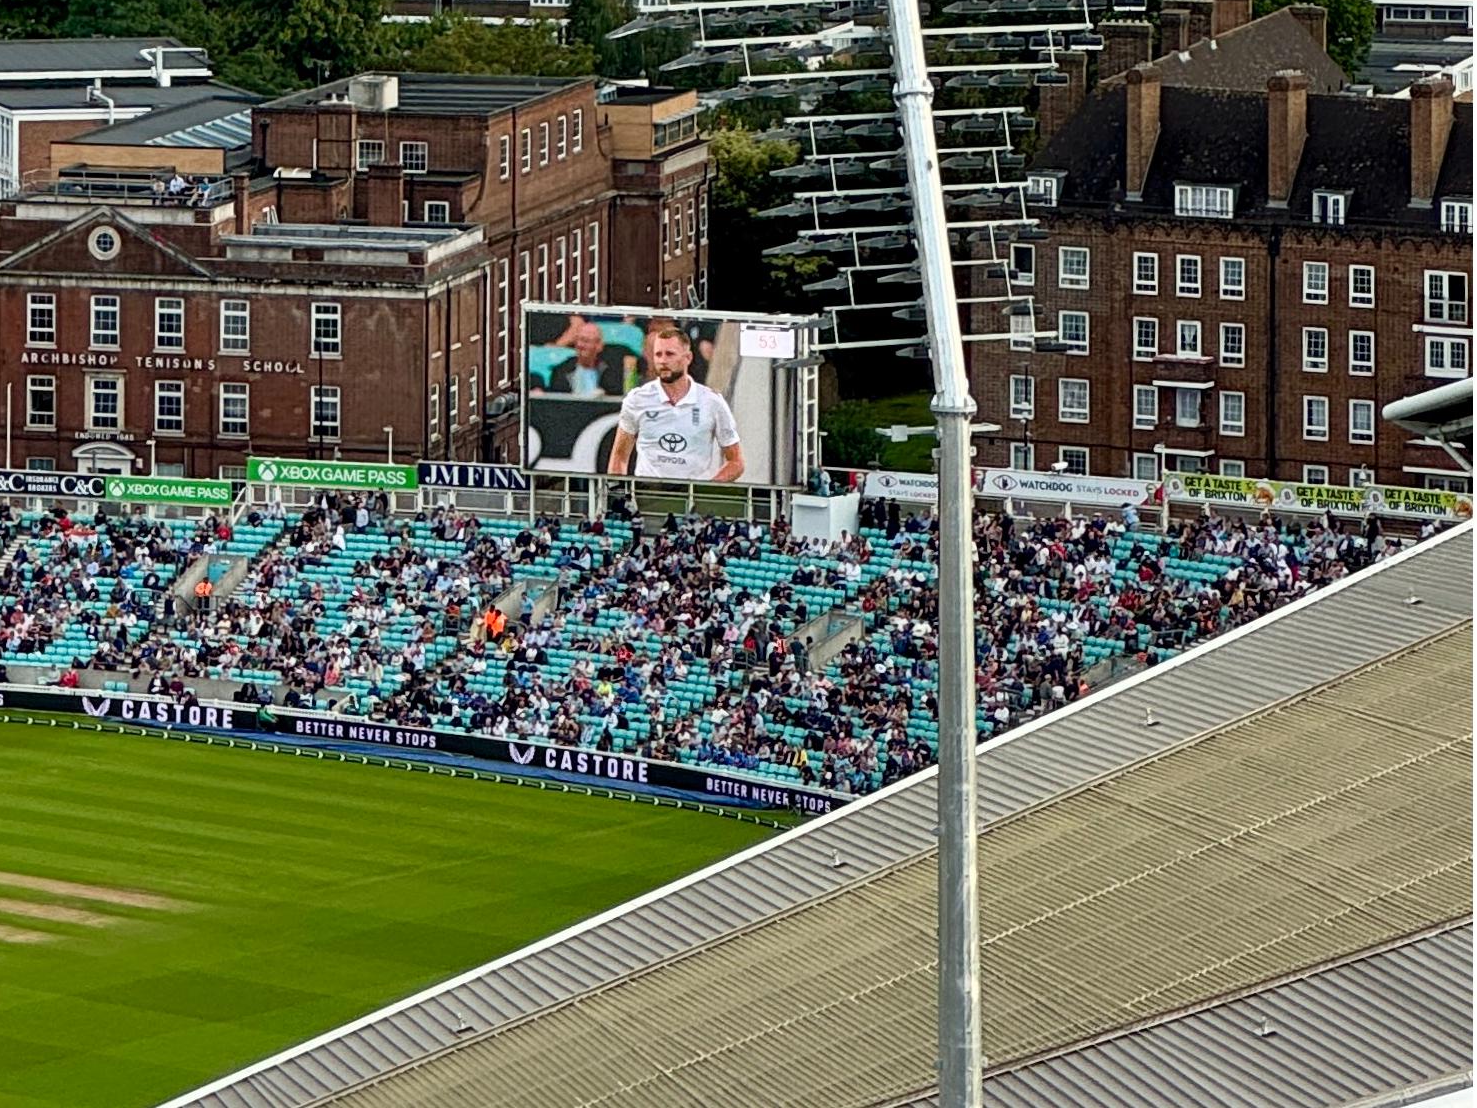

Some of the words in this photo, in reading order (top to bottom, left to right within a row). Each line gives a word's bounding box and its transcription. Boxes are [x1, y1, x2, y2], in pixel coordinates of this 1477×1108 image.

[758, 335, 777, 349] 53
[21, 352, 118, 366] ARCHBISHOP
[279, 465, 320, 480] XBOX
[320, 467, 366, 482] GAME
[367, 469, 407, 485] PASS
[425, 464, 461, 486] JM
[466, 467, 527, 489] FINN
[1184, 476, 1202, 489] GET
[1203, 478, 1211, 489] A
[1213, 478, 1242, 491] TASTE
[60, 476, 104, 496] C&C
[126, 483, 159, 496] XBOX
[161, 485, 196, 498] GAME
[198, 487, 229, 500] PASS
[1019, 478, 1073, 492] WATCHDOG
[1076, 485, 1102, 494] STAYS
[1104, 486, 1140, 497] LOCKED
[1297, 486, 1314, 498] GET
[1316, 488, 1324, 499] A
[1325, 489, 1354, 501] TASTE
[1188, 489, 1202, 498] OF
[1204, 489, 1247, 502] BRIXTON
[1385, 488, 1402, 501] GET
[1403, 491, 1411, 502] A
[1412, 491, 1441, 505] TASTE
[1300, 498, 1314, 508] OF
[1317, 499, 1360, 512] BRIXTON
[1389, 501, 1401, 510] OF
[1404, 502, 1447, 515] BRIXTON
[122, 700, 234, 730] CASTORE
[296, 720, 344, 737] BETTER
[349, 726, 390, 742] NEVER
[395, 731, 436, 749] STOPS
[545, 748, 649, 783] CASTORE
[707, 777, 748, 798] BETTER
[752, 786, 789, 806] NEVER
